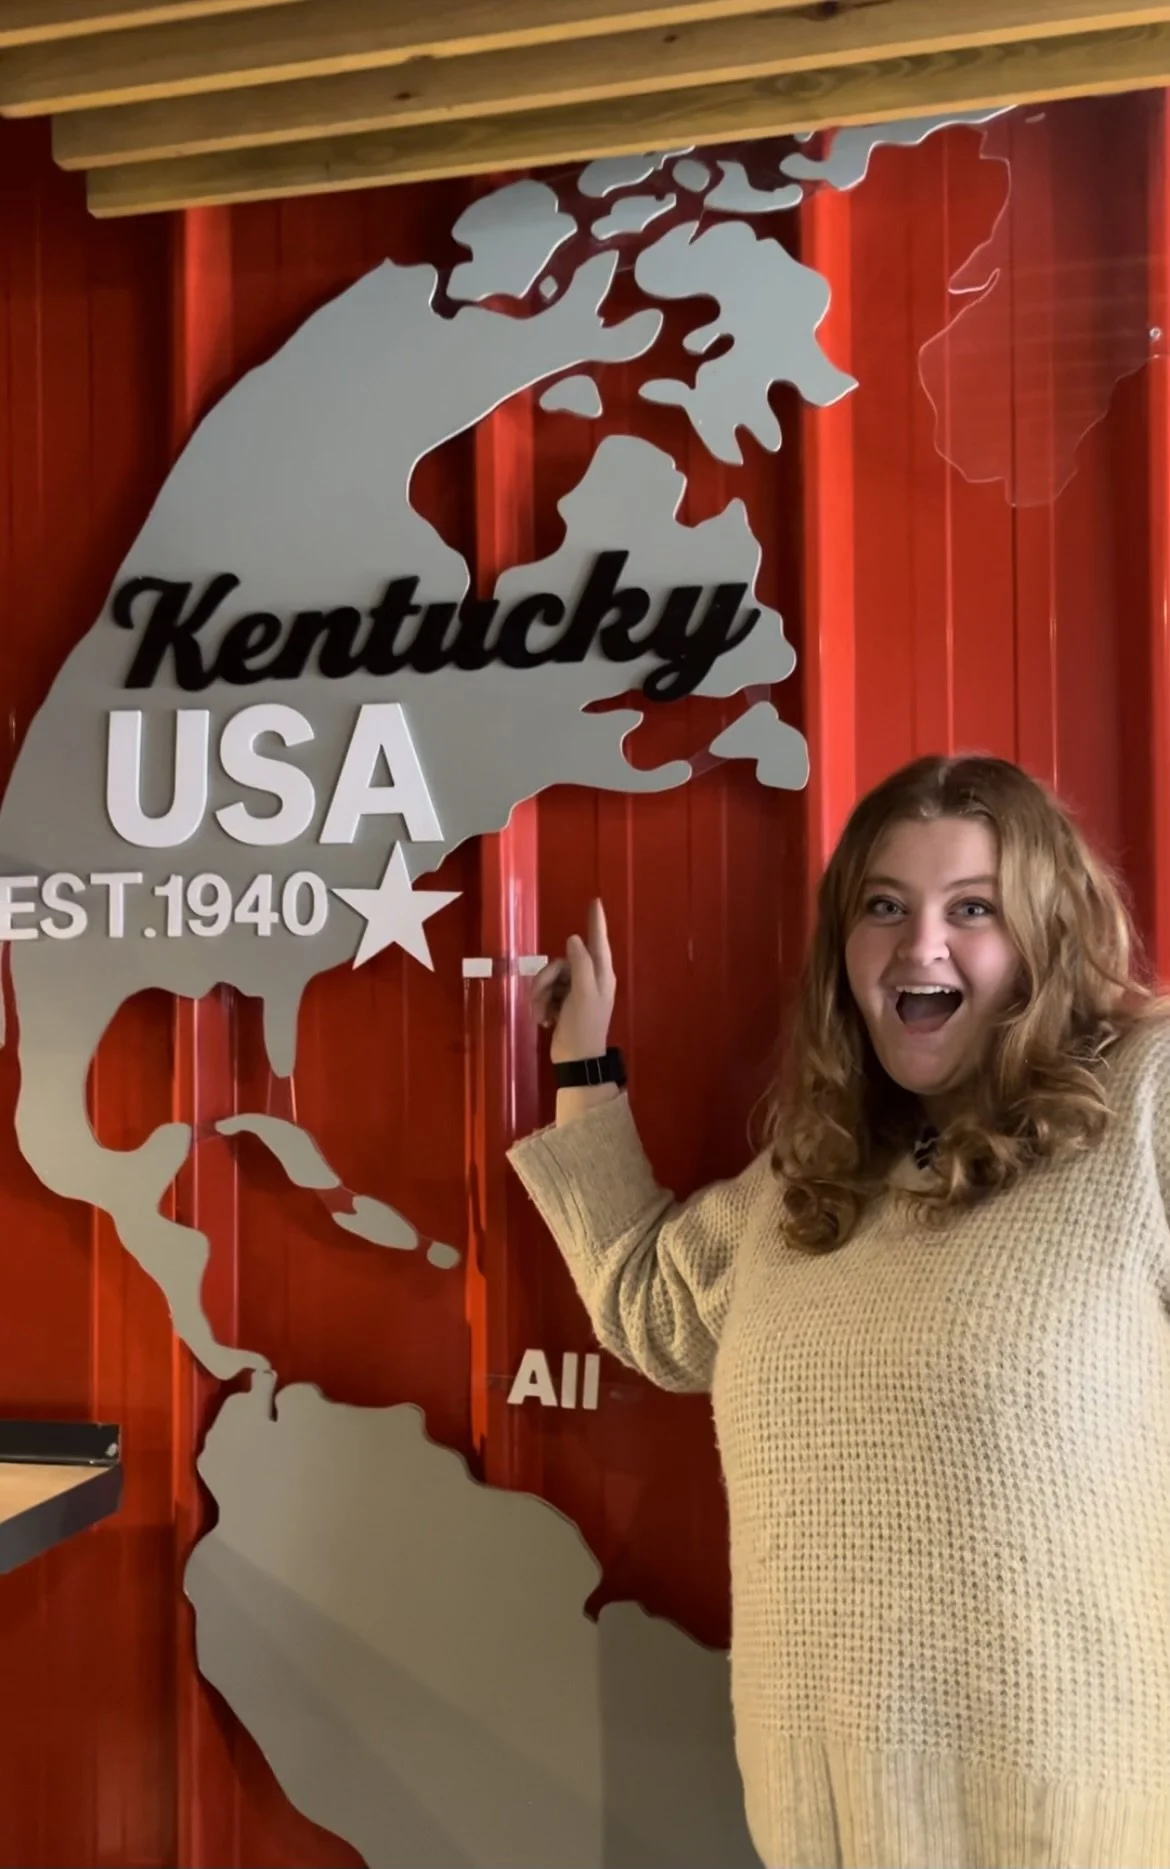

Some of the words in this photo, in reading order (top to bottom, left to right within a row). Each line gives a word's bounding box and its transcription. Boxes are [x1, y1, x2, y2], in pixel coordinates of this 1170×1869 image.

[113, 550, 761, 701] Kentucky
[106, 703, 445, 848] USA
[507, 1348, 600, 1410] All
